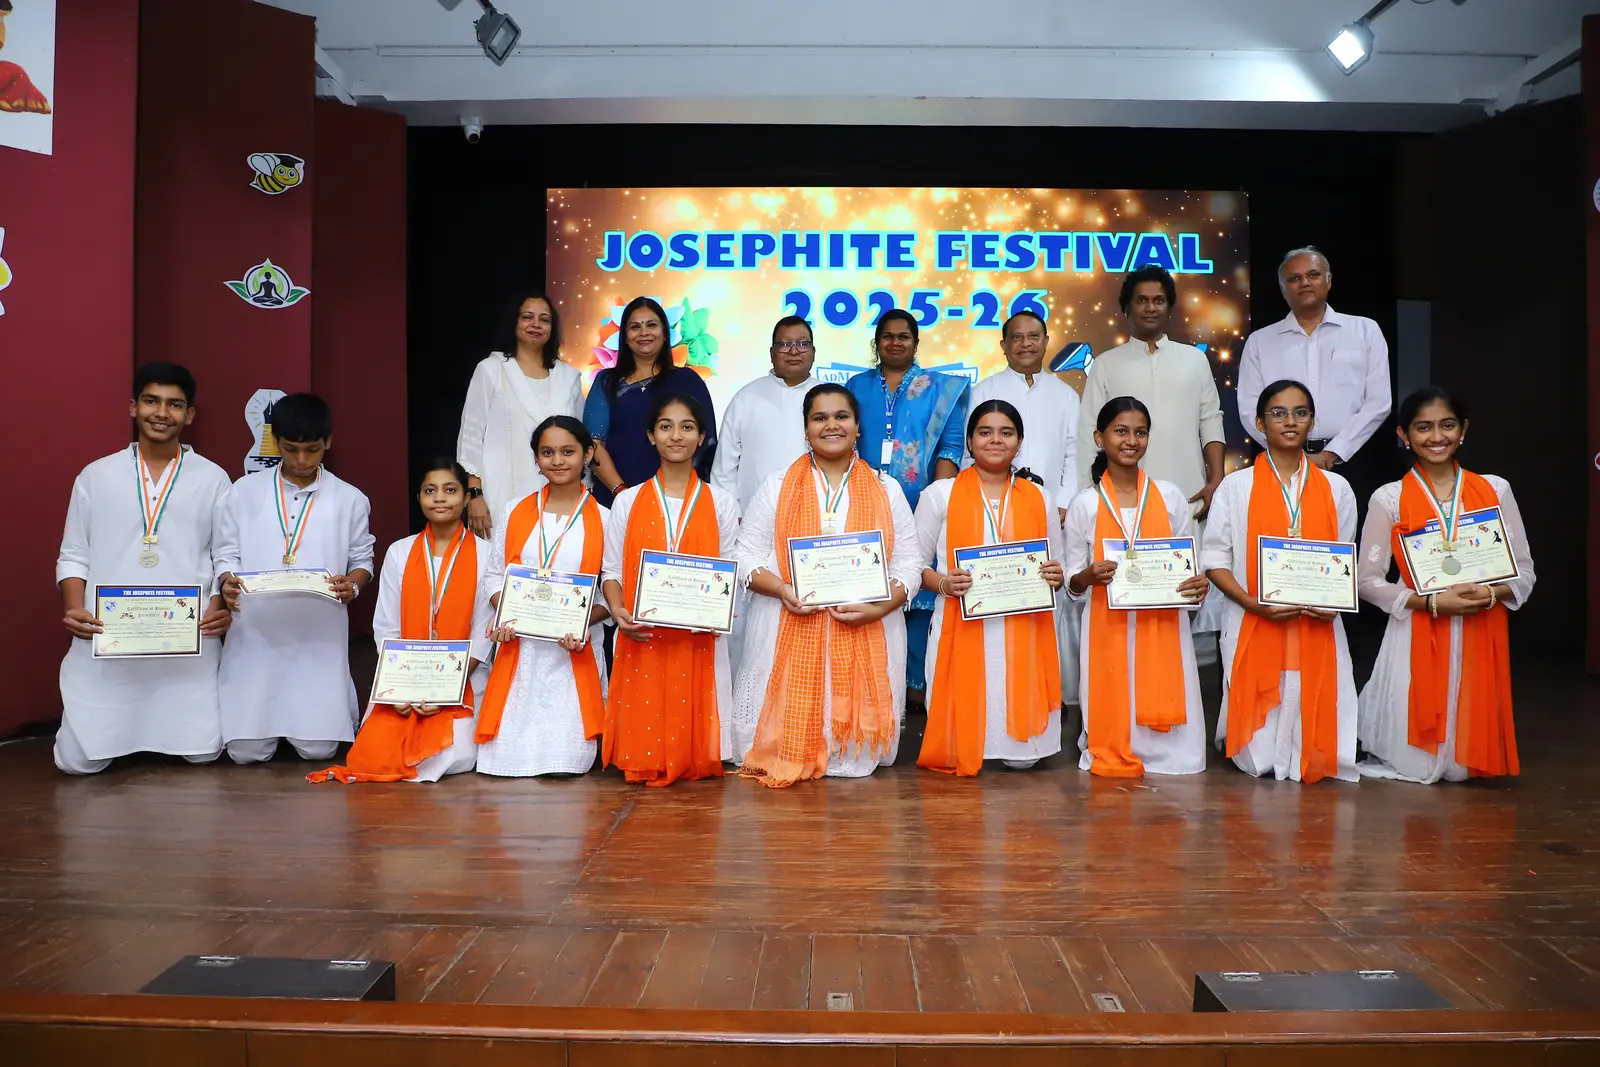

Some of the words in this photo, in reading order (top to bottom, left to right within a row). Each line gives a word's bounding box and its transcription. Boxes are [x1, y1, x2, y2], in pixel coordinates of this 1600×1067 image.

[596, 230, 918, 271] JOSEPHITE
[935, 231, 1213, 274] FESTIVAL
[782, 287, 1049, 330] 2025-26
